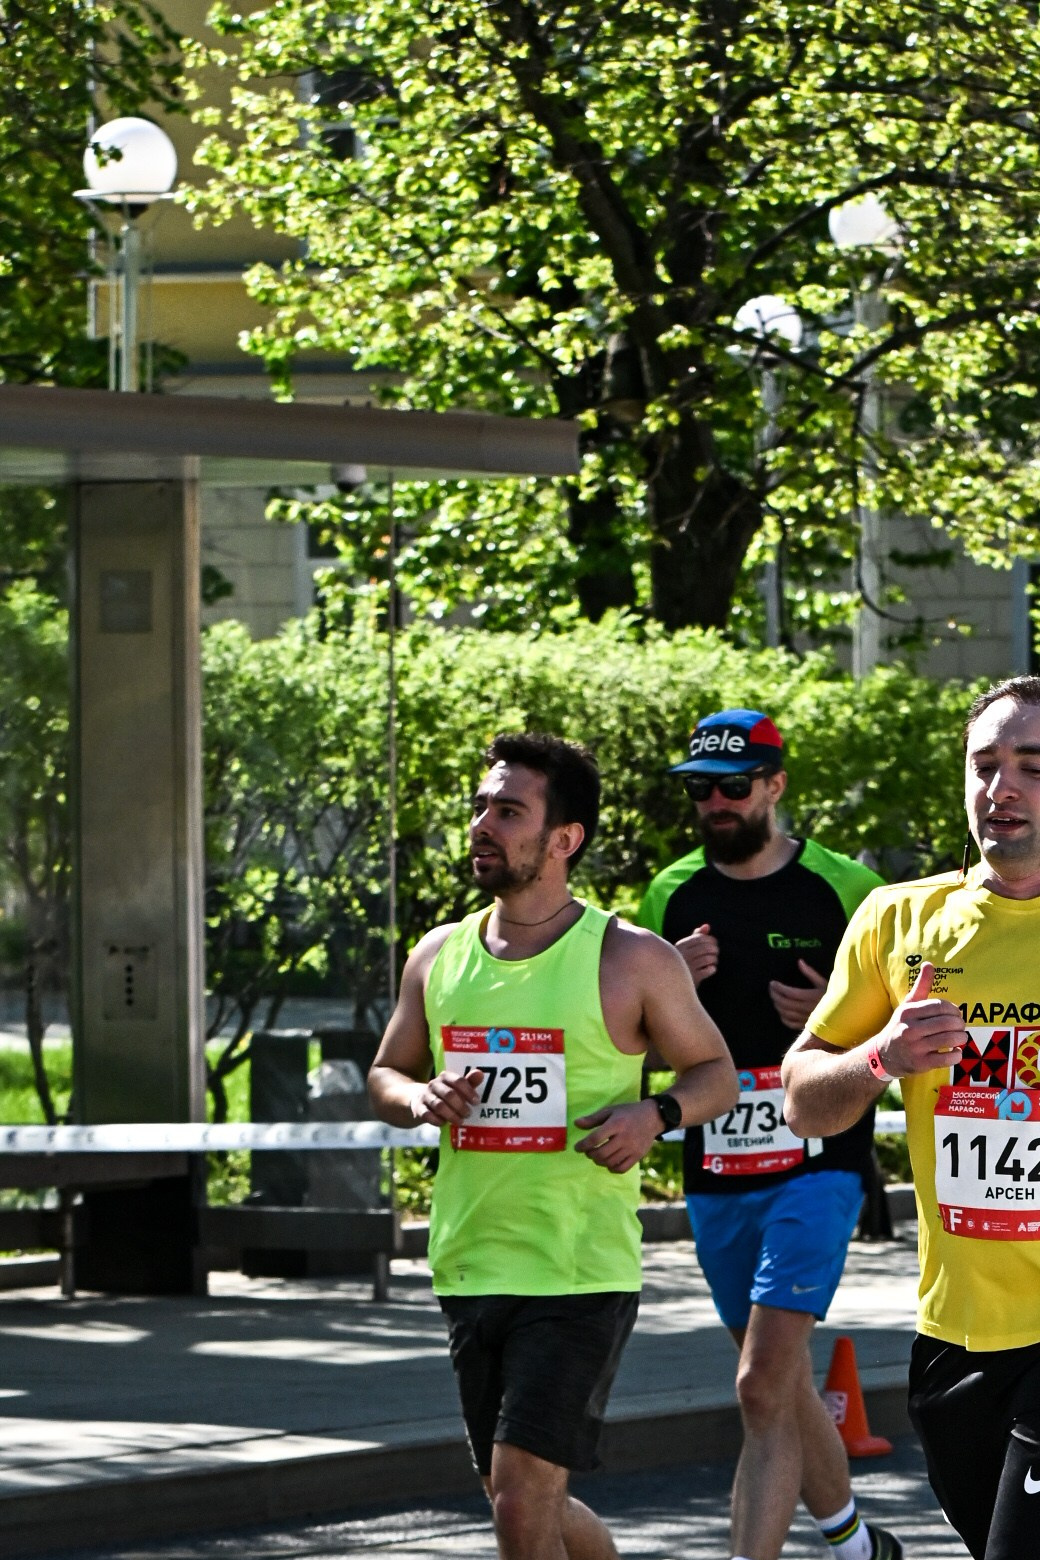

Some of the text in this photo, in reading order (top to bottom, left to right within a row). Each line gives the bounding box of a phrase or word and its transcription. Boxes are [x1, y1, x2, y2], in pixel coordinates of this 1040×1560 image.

[689, 729, 746, 757] ciele
[463, 1066, 548, 1104] 725
[479, 1107, 520, 1119] АРТЕМ
[709, 1101, 788, 1135] 1273
[457, 1127, 468, 1148] F
[727, 1134, 774, 1148] ЕВГЕНИЙ
[710, 1156, 723, 1174] G
[985, 1186, 1035, 1200] АРСЕН
[948, 1208, 963, 1232] F
